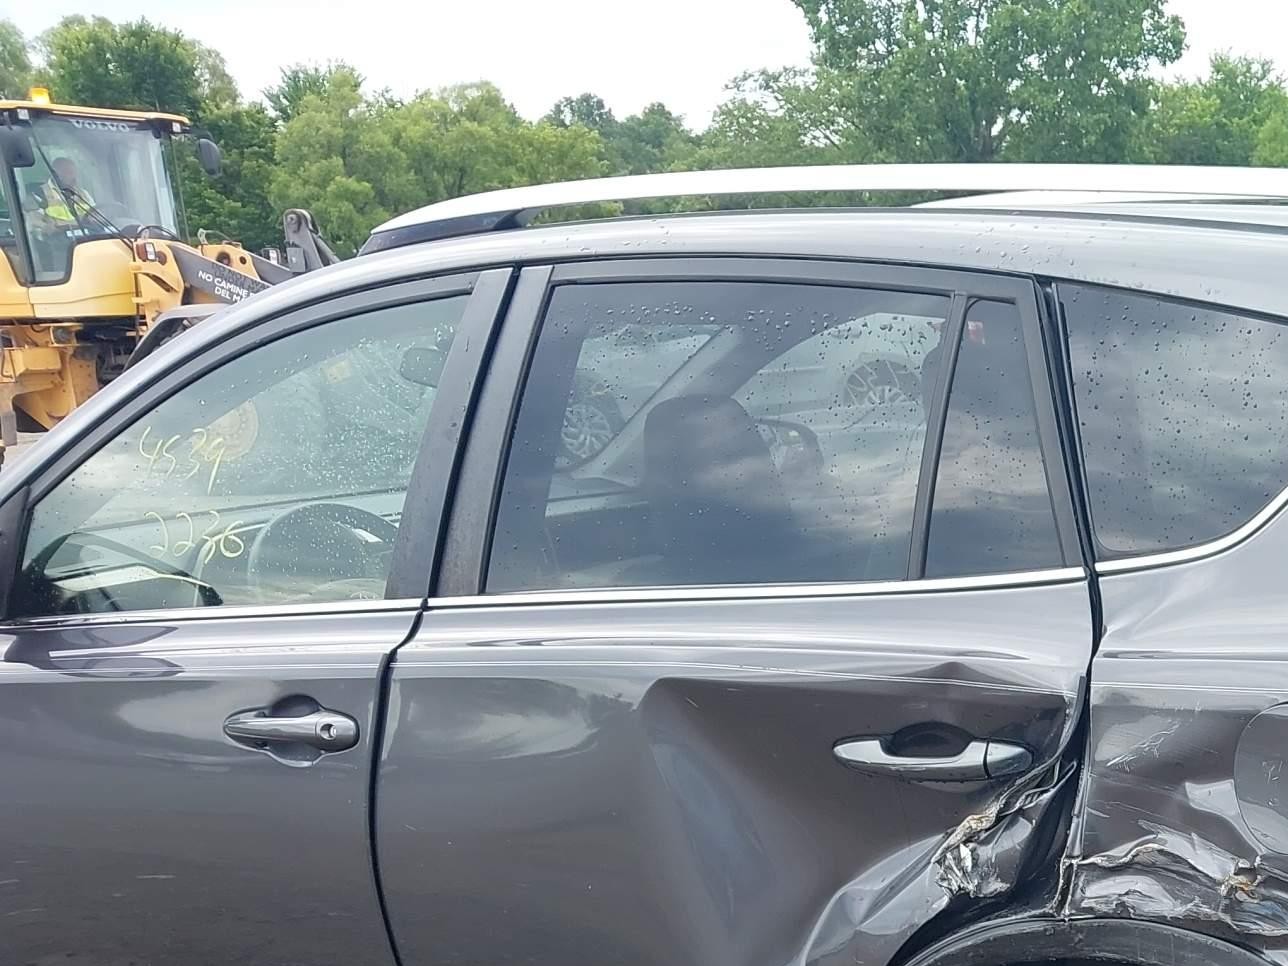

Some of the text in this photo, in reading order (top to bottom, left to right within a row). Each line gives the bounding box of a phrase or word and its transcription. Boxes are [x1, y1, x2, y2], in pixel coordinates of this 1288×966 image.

[69, 119, 130, 132] VOLVO
[198, 270, 213, 282] NO
[214, 278, 249, 298] CAMINE
[214, 286, 231, 300] DEL
[139, 426, 225, 496] 4539
[144, 510, 244, 564] 2236
